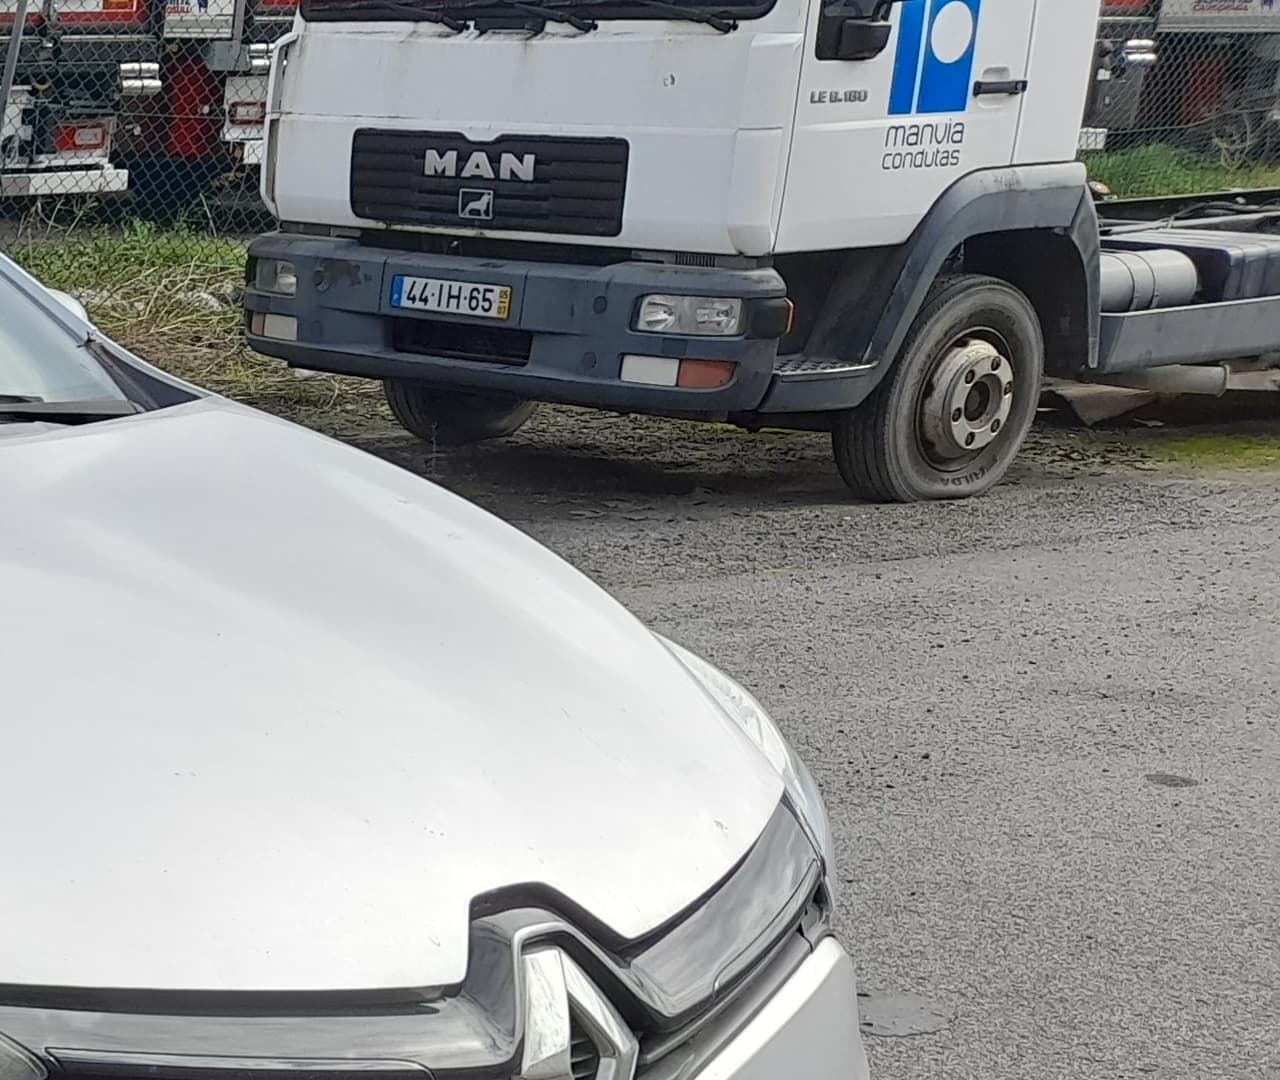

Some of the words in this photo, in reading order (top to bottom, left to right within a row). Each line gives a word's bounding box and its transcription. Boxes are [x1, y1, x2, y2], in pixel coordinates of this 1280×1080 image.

[885, 118, 965, 147] manvia
[424, 149, 535, 181] MAN
[882, 148, 960, 170] condutas
